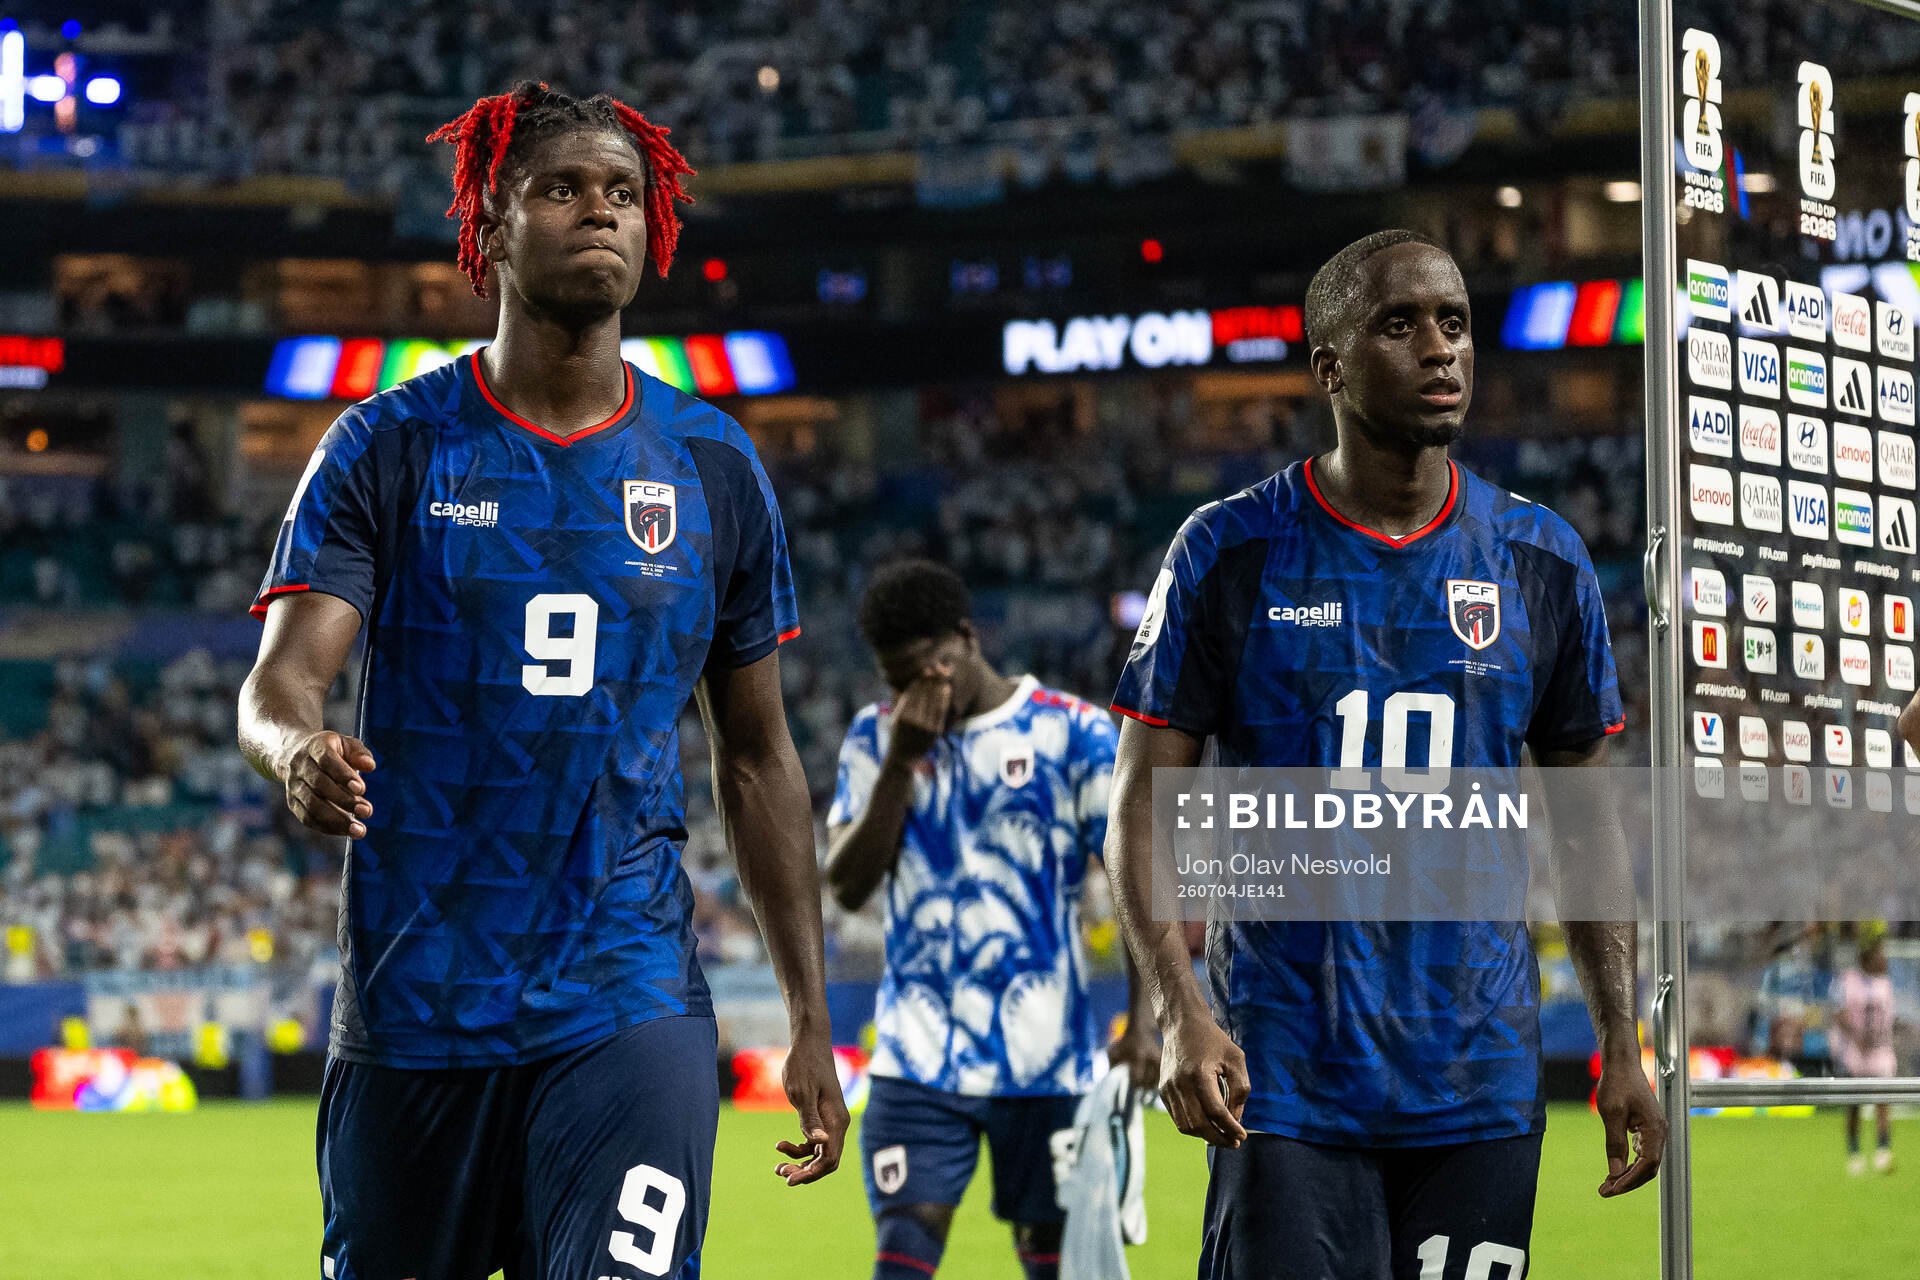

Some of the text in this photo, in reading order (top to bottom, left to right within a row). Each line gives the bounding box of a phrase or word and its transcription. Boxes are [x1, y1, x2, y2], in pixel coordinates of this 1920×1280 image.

[1695, 142, 1713, 158] FIFA
[1685, 170, 1723, 191] WORLD CUP
[1810, 170, 1826, 187] FIFA
[1684, 185, 1724, 214] 2026
[1800, 199, 1836, 219] WORLD CUP
[1800, 214, 1836, 241] 2026
[1690, 277, 1728, 301] aramco
[1798, 295, 1824, 321] ADI
[1003, 316, 1131, 375] PLAY
[1131, 309, 1213, 367] ON
[1690, 338, 1729, 364] QATAR
[1881, 339, 1910, 353] HYUNDAI
[1742, 351, 1778, 385] VISA
[1789, 366, 1824, 388] aramco
[1889, 381, 1913, 404] ADI
[1702, 410, 1730, 436] ADI
[1792, 451, 1824, 466] HYUNDAI
[1836, 441, 1871, 464] Lenovo
[1880, 442, 1914, 463] QATAR
[629, 485, 671, 497] FCF
[1692, 483, 1732, 506] Lenovo
[1742, 483, 1780, 505] QATAR
[429, 501, 500, 522] capelli
[1792, 494, 1827, 527] VISA
[1838, 507, 1871, 529] aramco
[456, 518, 498, 528] SPORT
[1453, 584, 1494, 596] FCF
[1268, 602, 1342, 625] capelli
[1794, 598, 1823, 610] Hisense
[522, 593, 599, 697] 9
[1799, 655, 1819, 673] Dove
[1843, 656, 1869, 671] verizon
[1330, 689, 1456, 794] 10
[1708, 771, 1723, 786] PIF
[608, 1164, 686, 1277] 9
